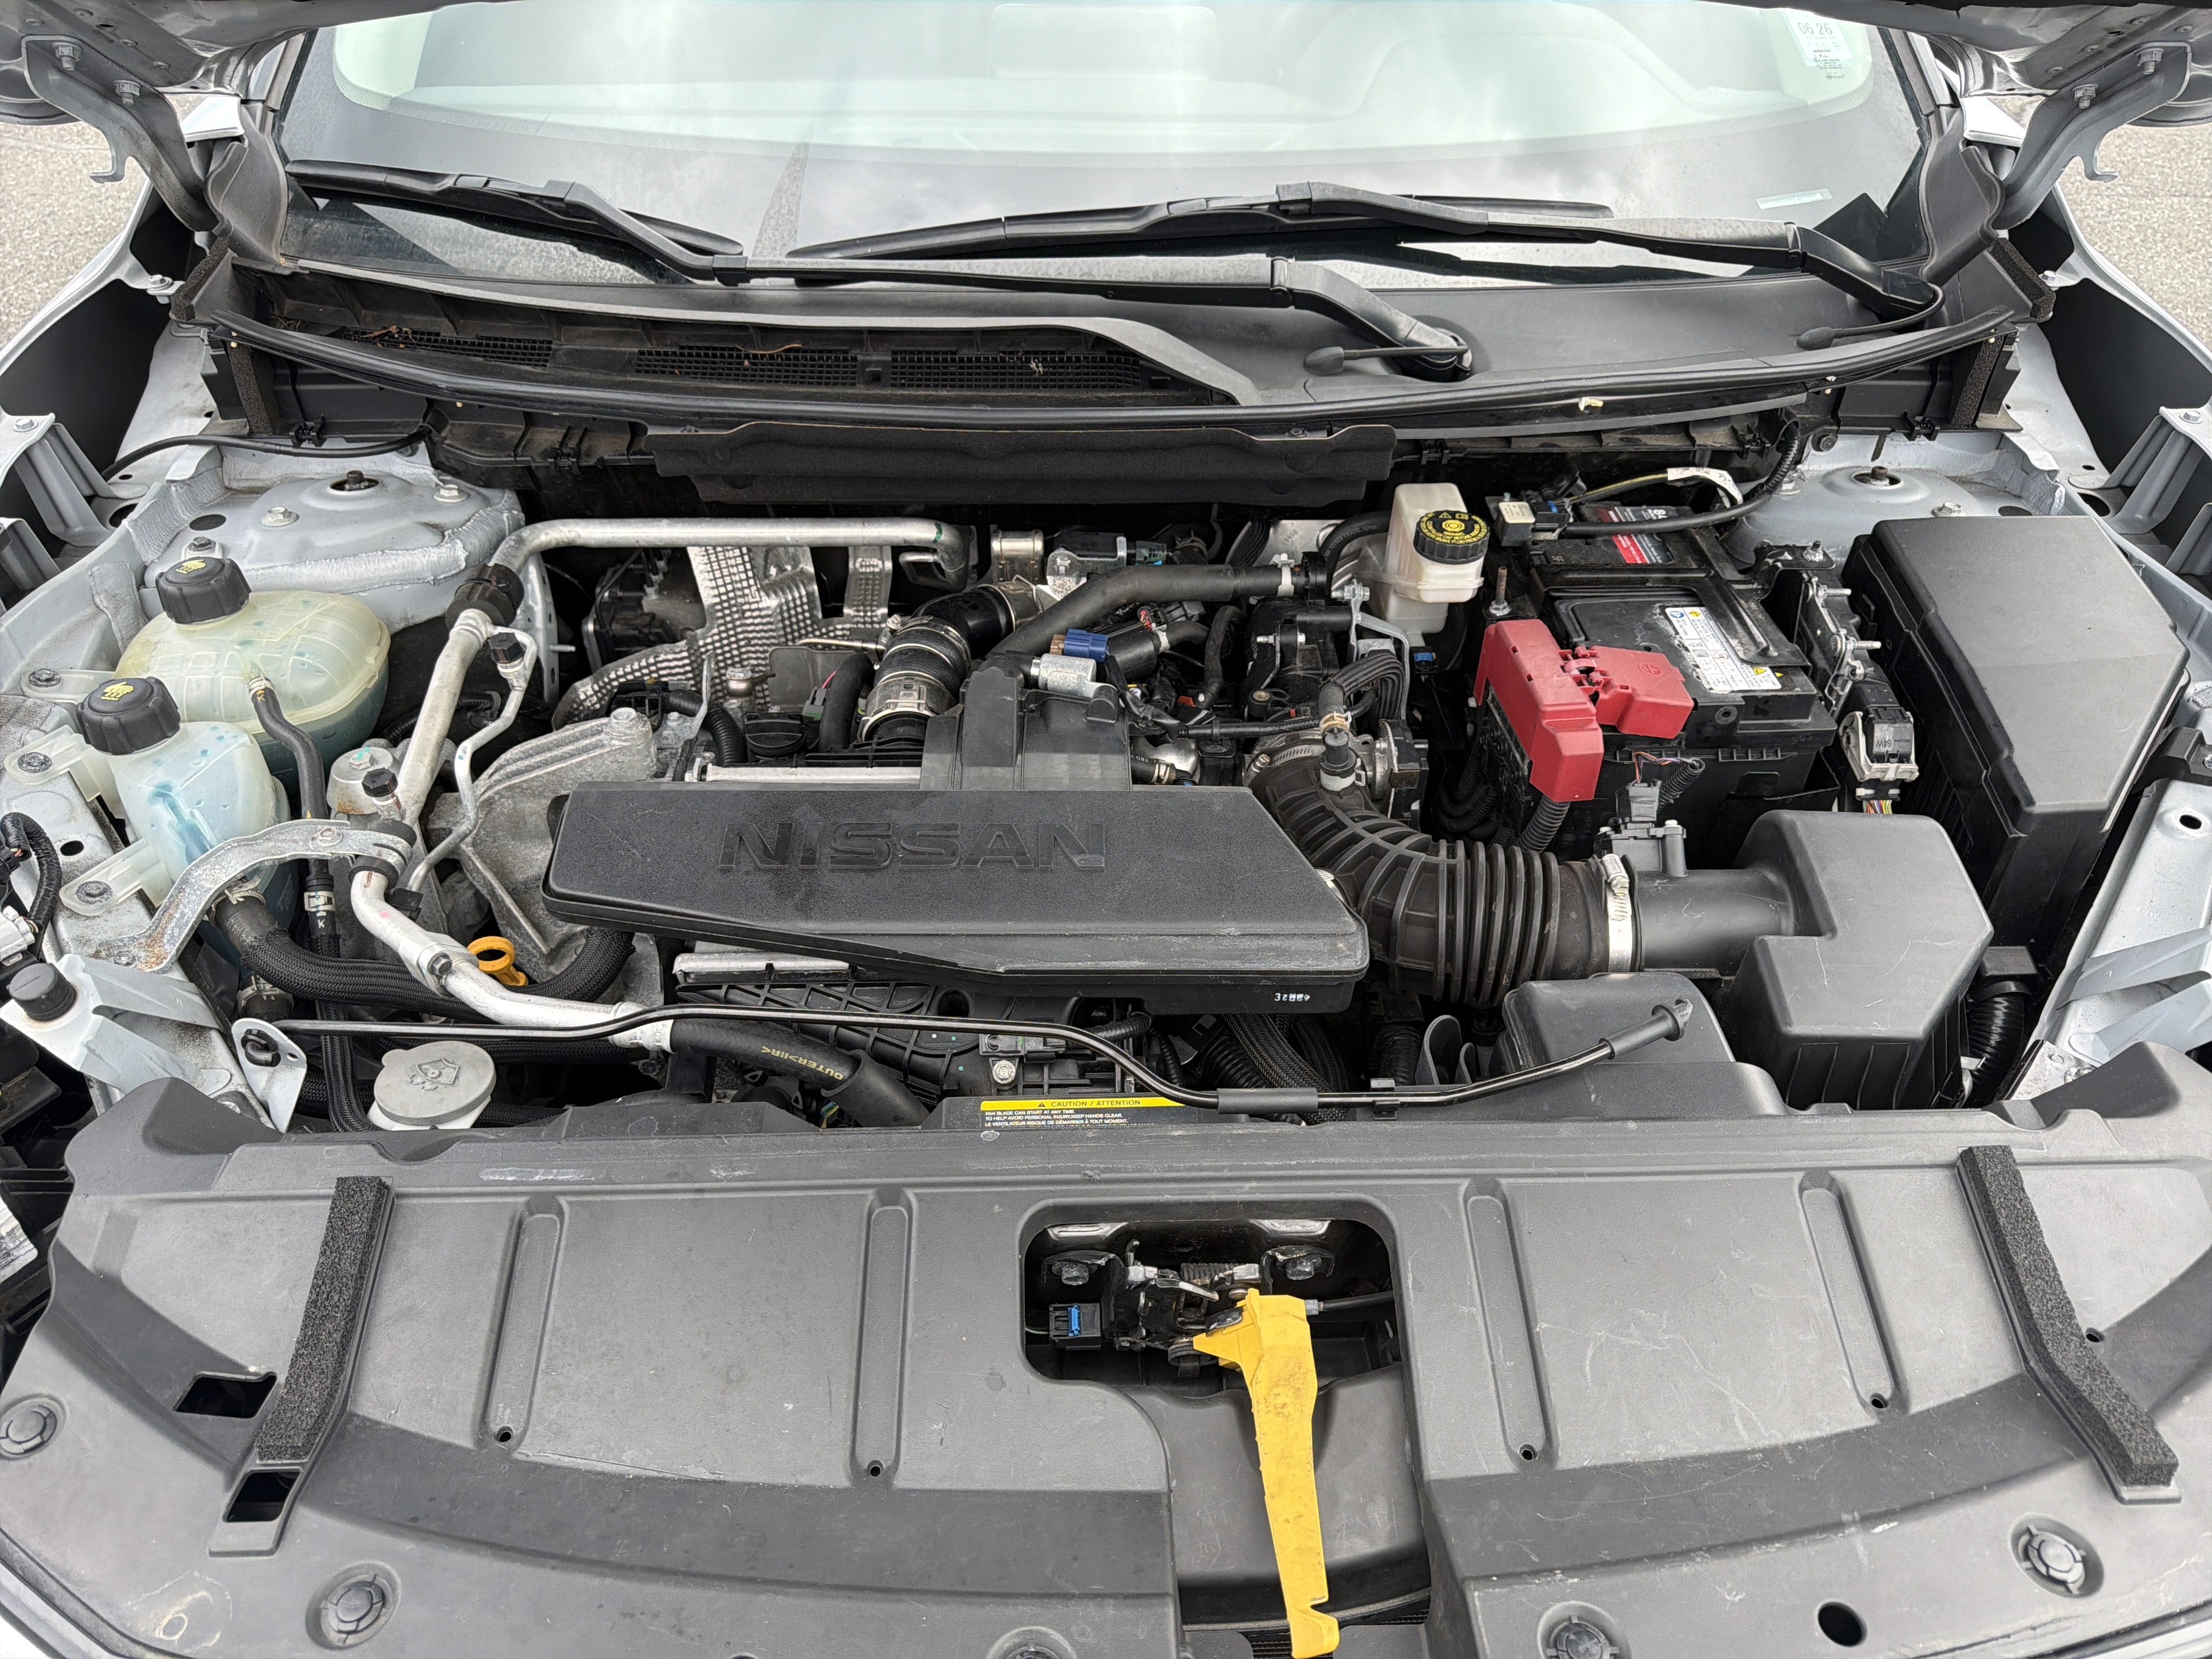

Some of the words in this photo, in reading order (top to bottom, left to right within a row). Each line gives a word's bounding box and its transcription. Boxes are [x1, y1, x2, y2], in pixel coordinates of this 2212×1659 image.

[1798, 22, 1814, 35] 06
[1816, 22, 1833, 35] 26
[1876, 738, 1892, 748] 64W
[718, 822, 1106, 870] NISSAN
[318, 918, 325, 929] K
